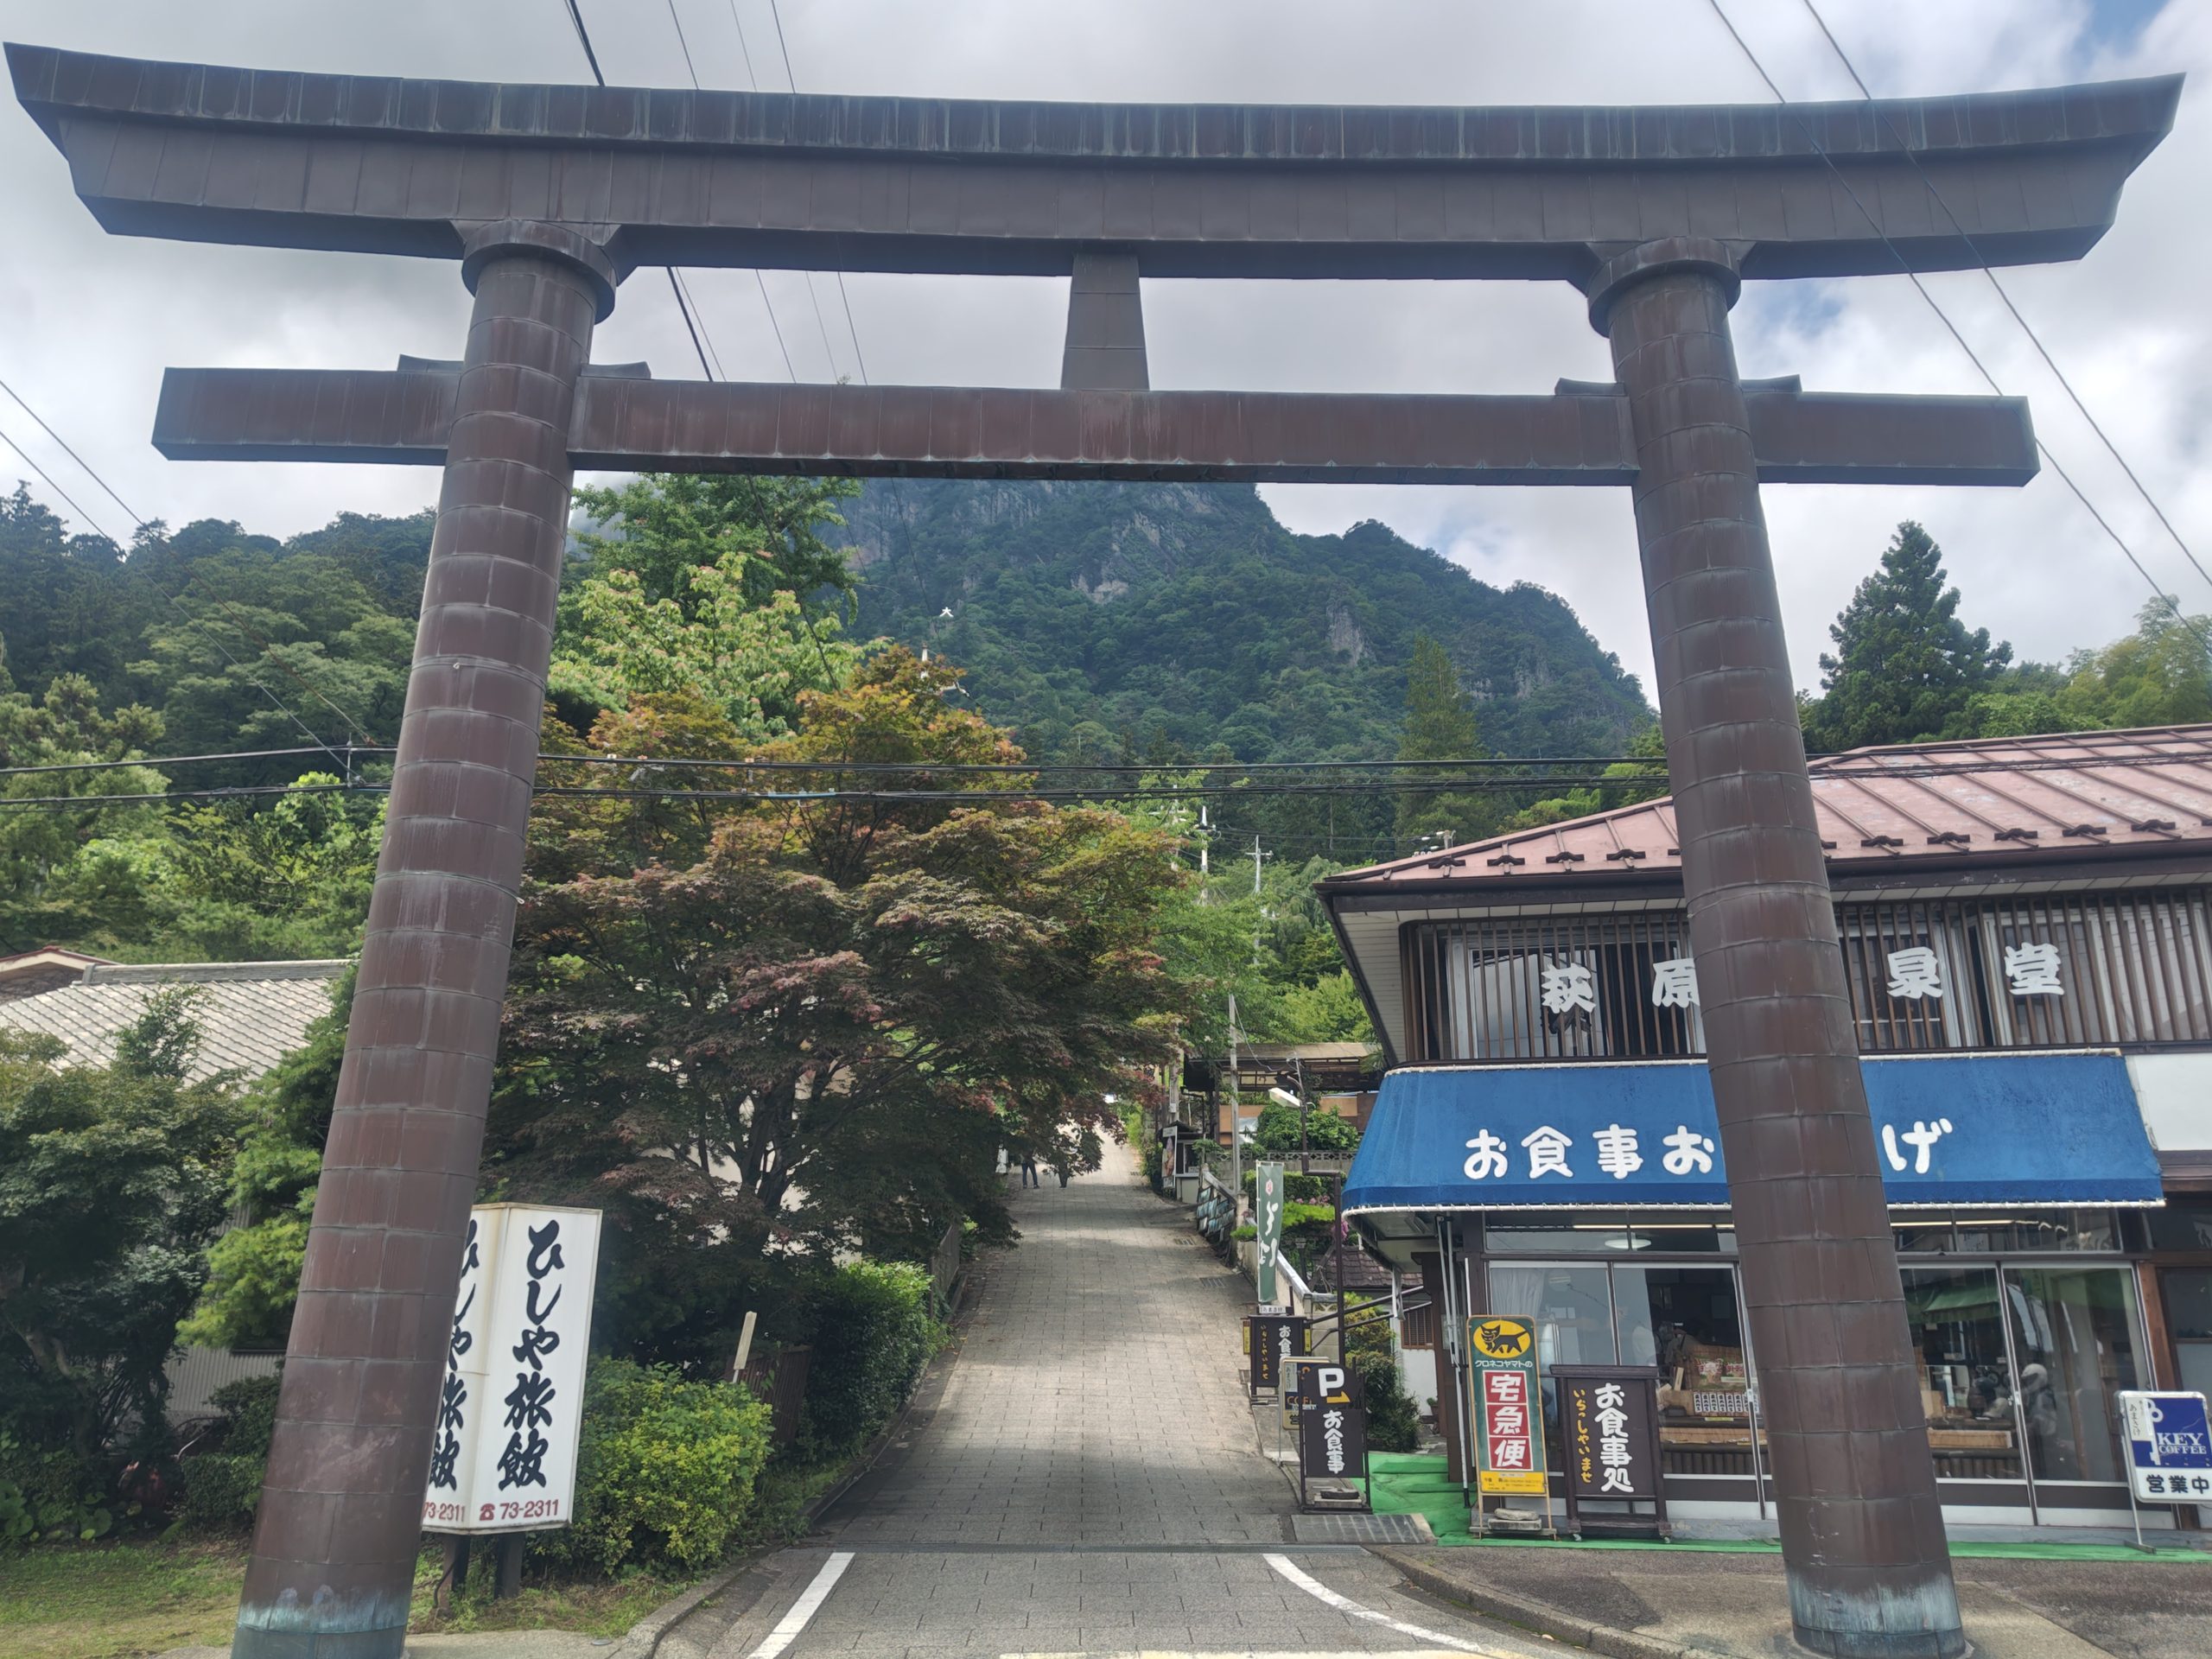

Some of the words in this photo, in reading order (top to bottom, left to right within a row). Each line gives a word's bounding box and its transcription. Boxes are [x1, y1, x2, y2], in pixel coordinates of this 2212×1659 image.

[1279, 1325, 1292, 1357] お食
[1474, 1360, 1533, 1369] クロネコヤマトの
[1318, 1368, 1344, 1397] P
[1490, 1374, 1526, 1468] 宅急便
[1323, 1409, 1345, 1474] お食事
[1594, 1382, 1634, 1493] お食事処
[2157, 1433, 2203, 1446] KEY
[2158, 1446, 2207, 1454] COFFEE
[2146, 1474, 2209, 1494] 営業中
[499, 1499, 559, 1520] 73-2311
